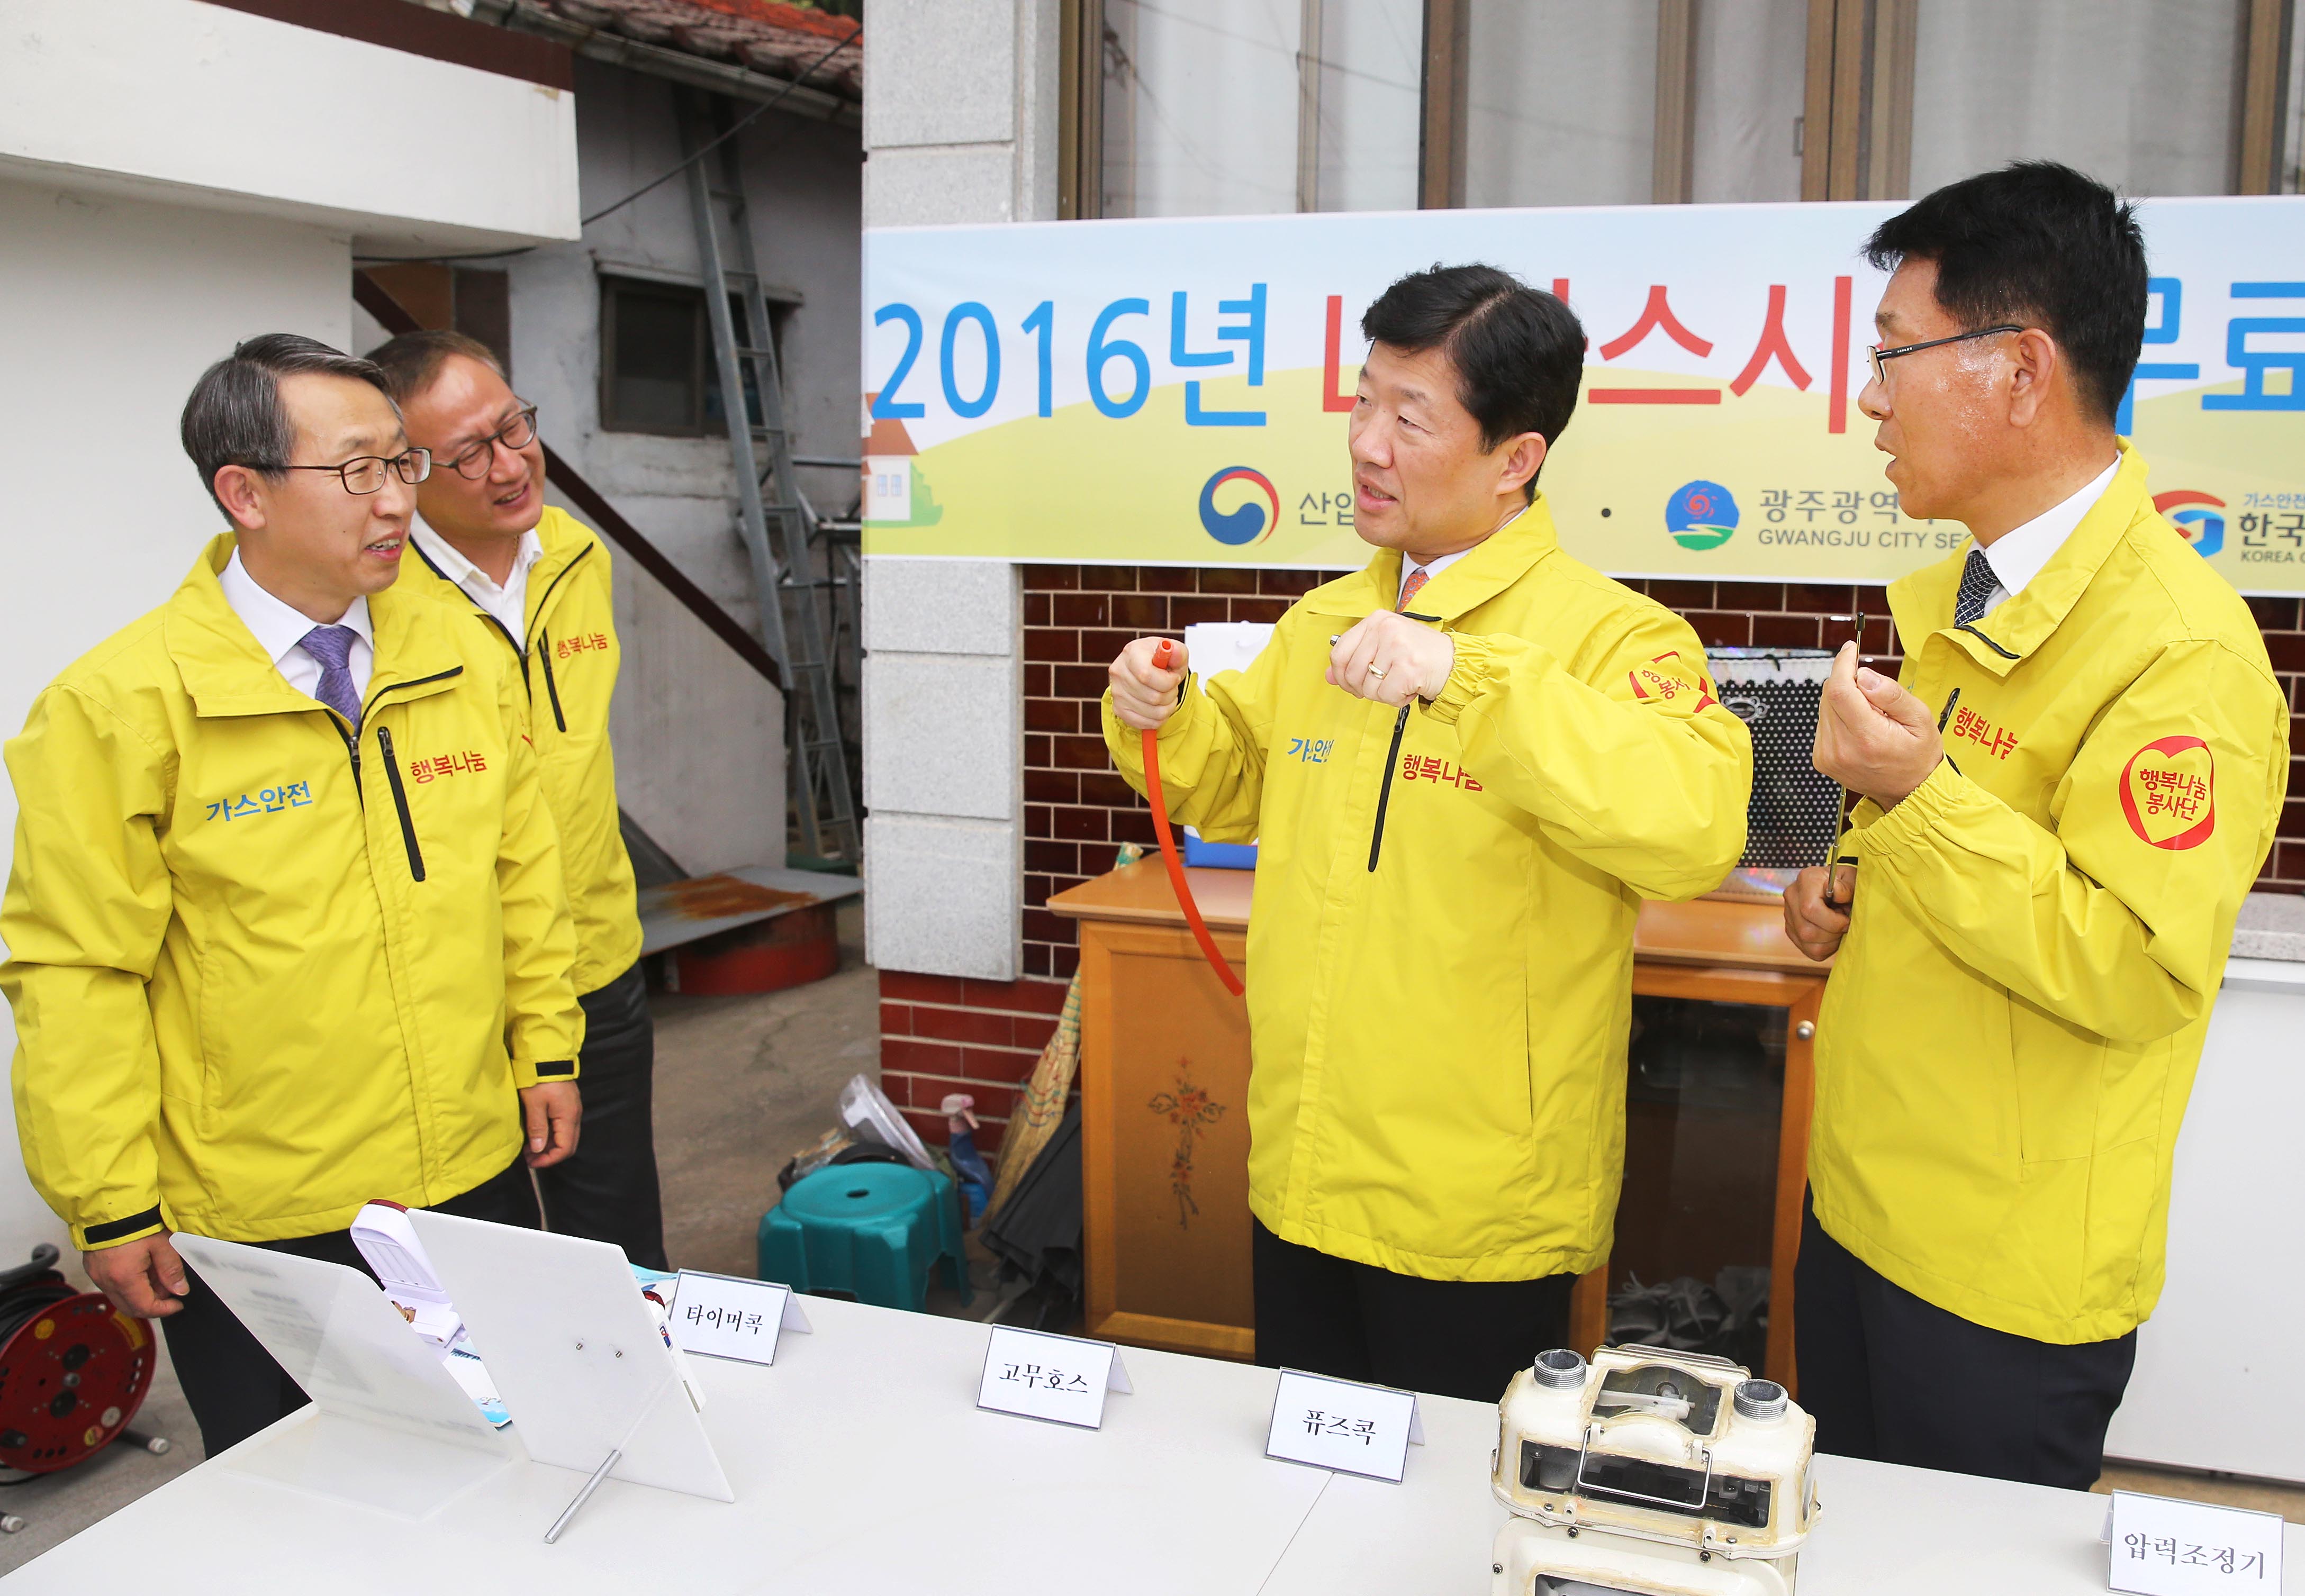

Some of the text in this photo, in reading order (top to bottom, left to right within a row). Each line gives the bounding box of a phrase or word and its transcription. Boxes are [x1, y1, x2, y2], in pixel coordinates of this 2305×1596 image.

[872, 283, 1268, 426] 2016년
[1759, 530, 1870, 547] GWANGJU
[1878, 532, 1927, 548] CITY
[2240, 550, 2295, 564] KOREA
[558, 632, 608, 659] 행복나눔
[410, 750, 487, 784] 행복나눔
[2139, 768, 2207, 801] 행복나눔
[206, 780, 313, 822] 가스안전
[2145, 792, 2198, 821] 봉사단
[686, 1304, 763, 1335] 타이머콕
[999, 1363, 1088, 1395] 고무호스
[1303, 1409, 1377, 1446] 퓨즈콕
[2125, 1532, 2264, 1579] 압력조정기
